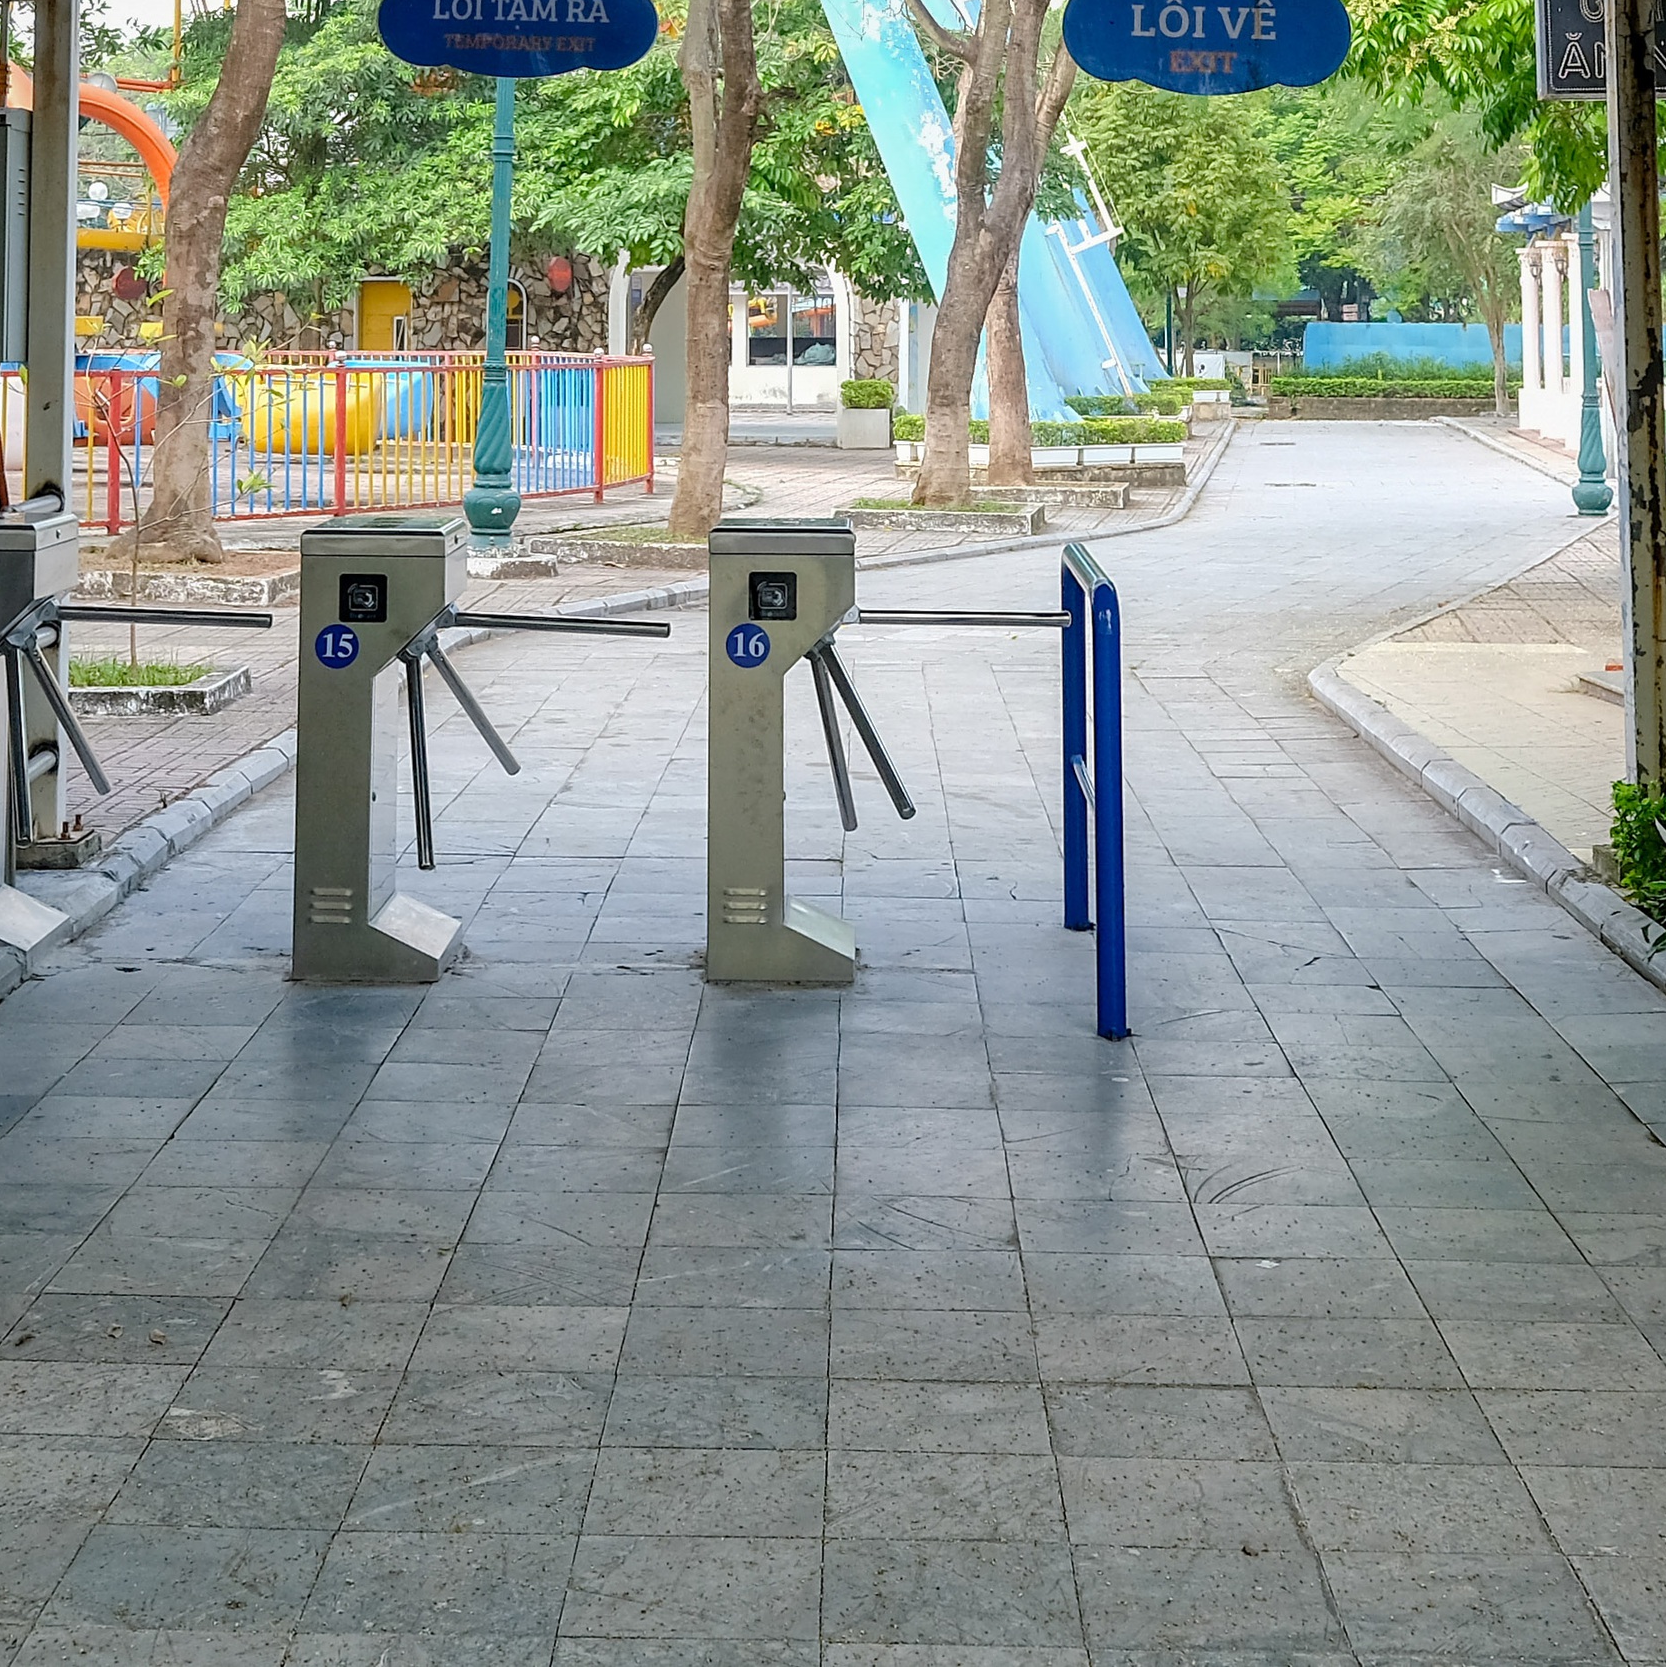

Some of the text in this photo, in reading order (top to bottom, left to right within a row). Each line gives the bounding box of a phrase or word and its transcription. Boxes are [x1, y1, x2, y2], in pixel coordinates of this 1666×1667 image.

[444, 33, 597, 53] TEMPORARY EXIT
[1169, 50, 1238, 74] EXIT
[322, 632, 354, 659] 15
[733, 632, 765, 658] 16
